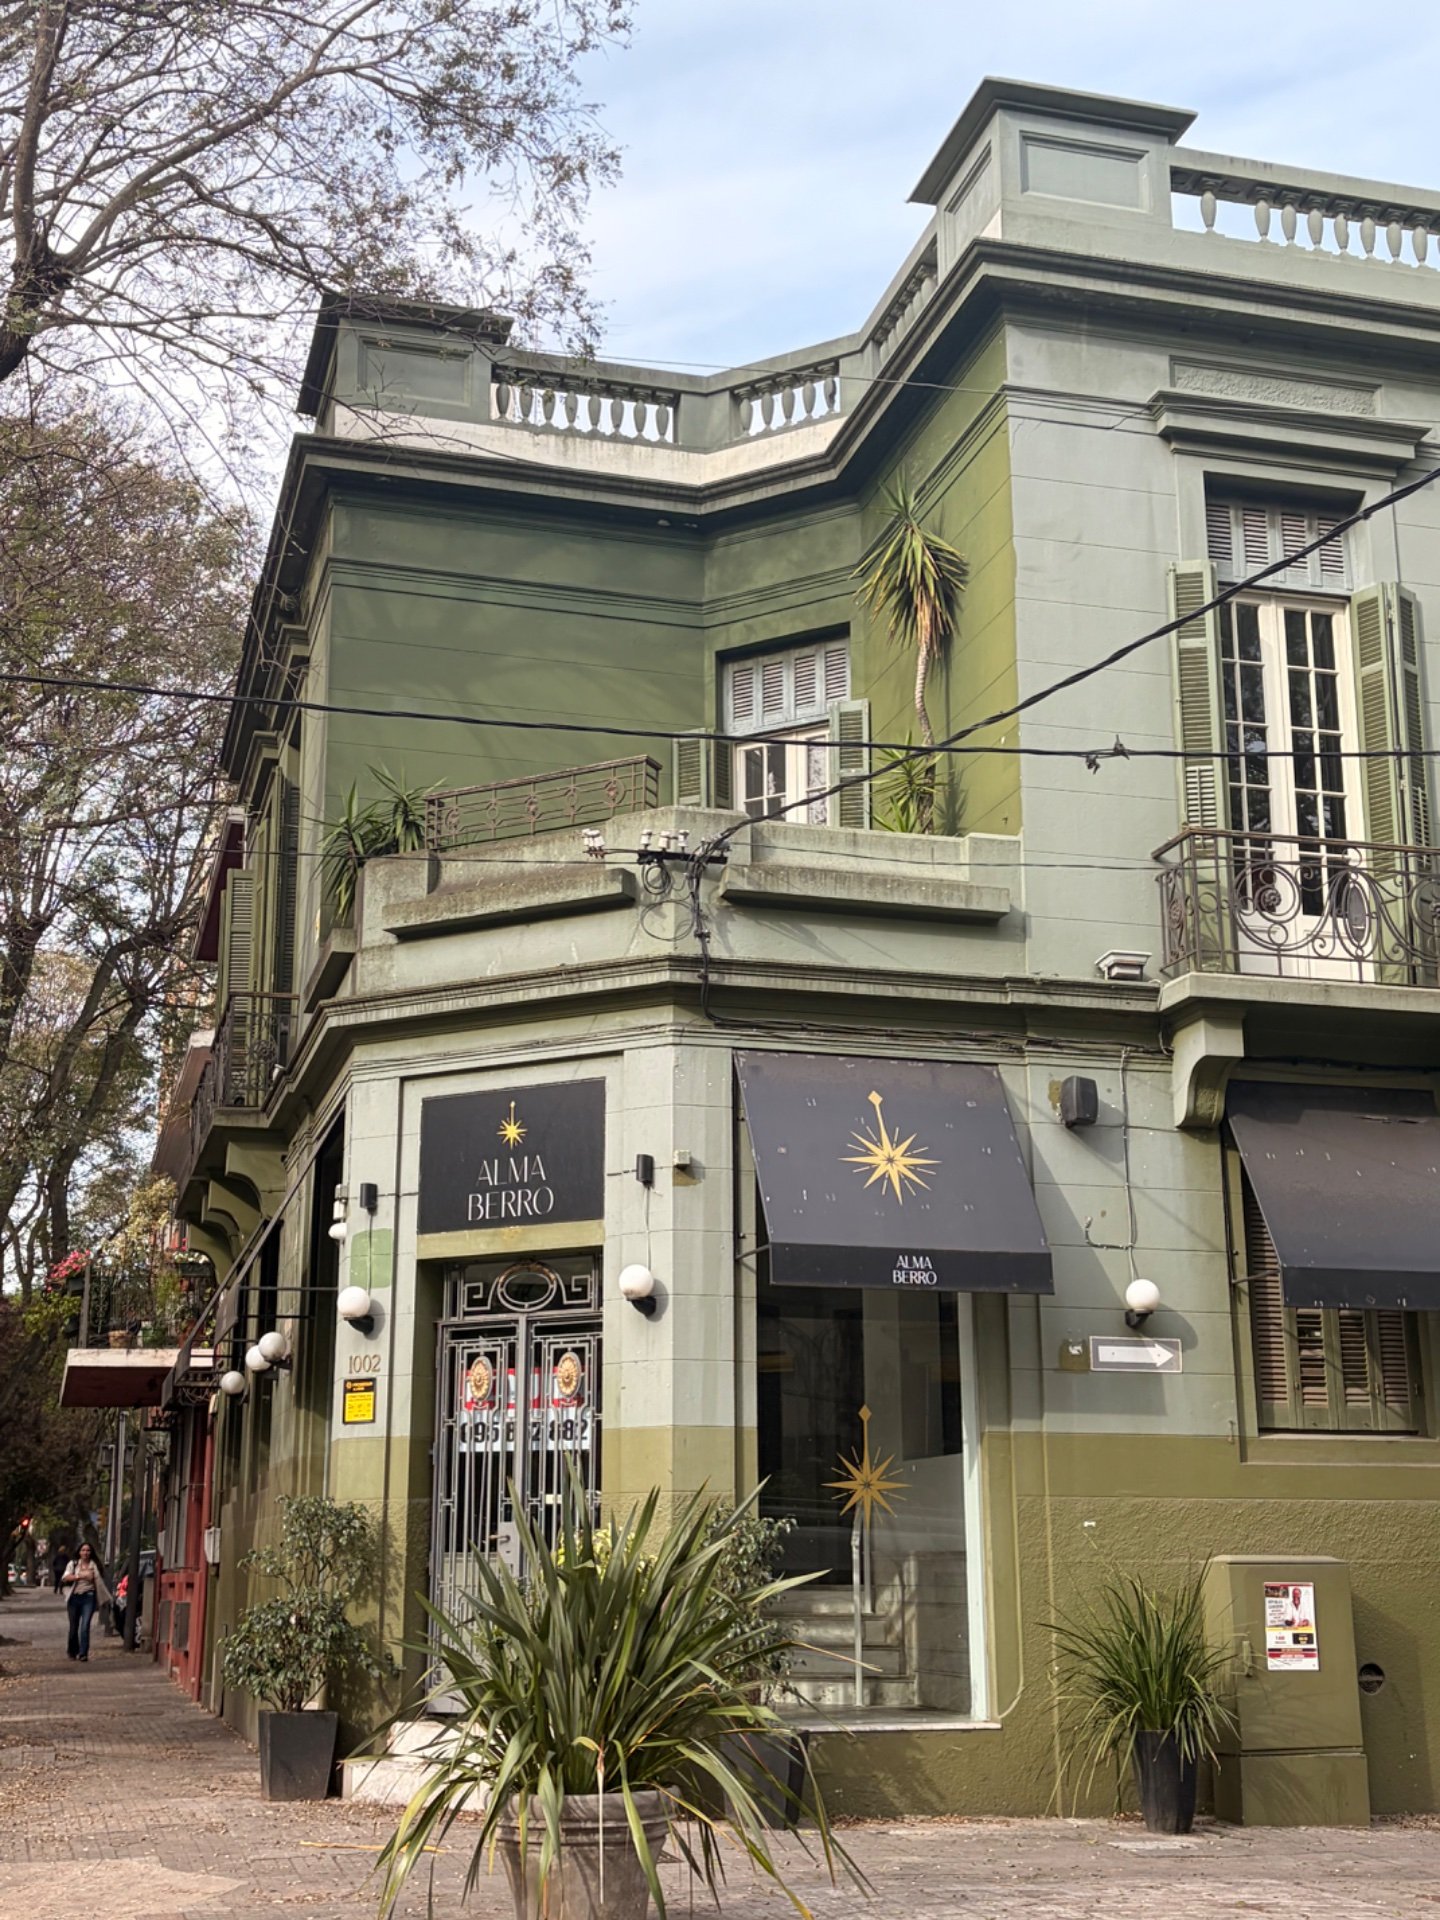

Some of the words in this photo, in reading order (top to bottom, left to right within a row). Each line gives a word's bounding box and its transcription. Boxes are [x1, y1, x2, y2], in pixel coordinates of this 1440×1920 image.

[476, 1154, 546, 1186] ALMA
[467, 1186, 554, 1221] BERRO
[896, 1255, 932, 1269] ALMA
[893, 1270, 937, 1285] BERRO
[349, 1354, 381, 1374] 1002
